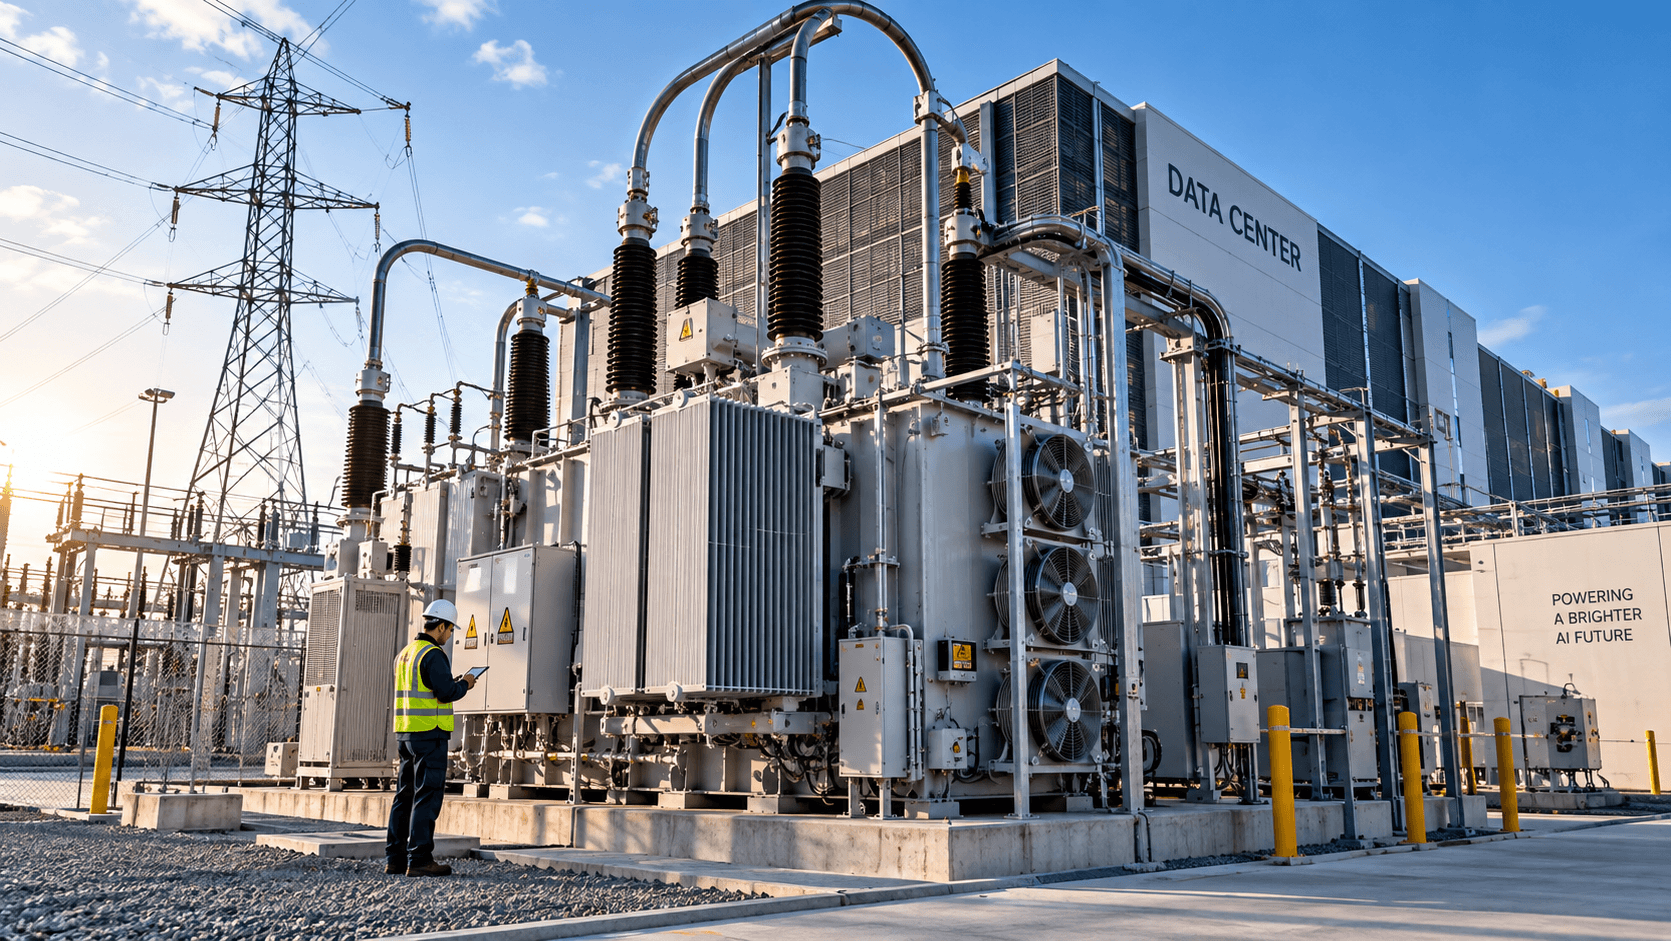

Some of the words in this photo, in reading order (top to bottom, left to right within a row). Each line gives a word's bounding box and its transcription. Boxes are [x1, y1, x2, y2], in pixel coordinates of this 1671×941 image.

[1168, 163, 1223, 224] DATA
[1229, 205, 1301, 272] CENTER
[1552, 588, 1633, 606] POWERING
[1554, 613, 1564, 625] A
[1568, 608, 1642, 624] BRIGHTER
[1556, 632, 1569, 644] AI
[1575, 628, 1633, 643] FUTURE
